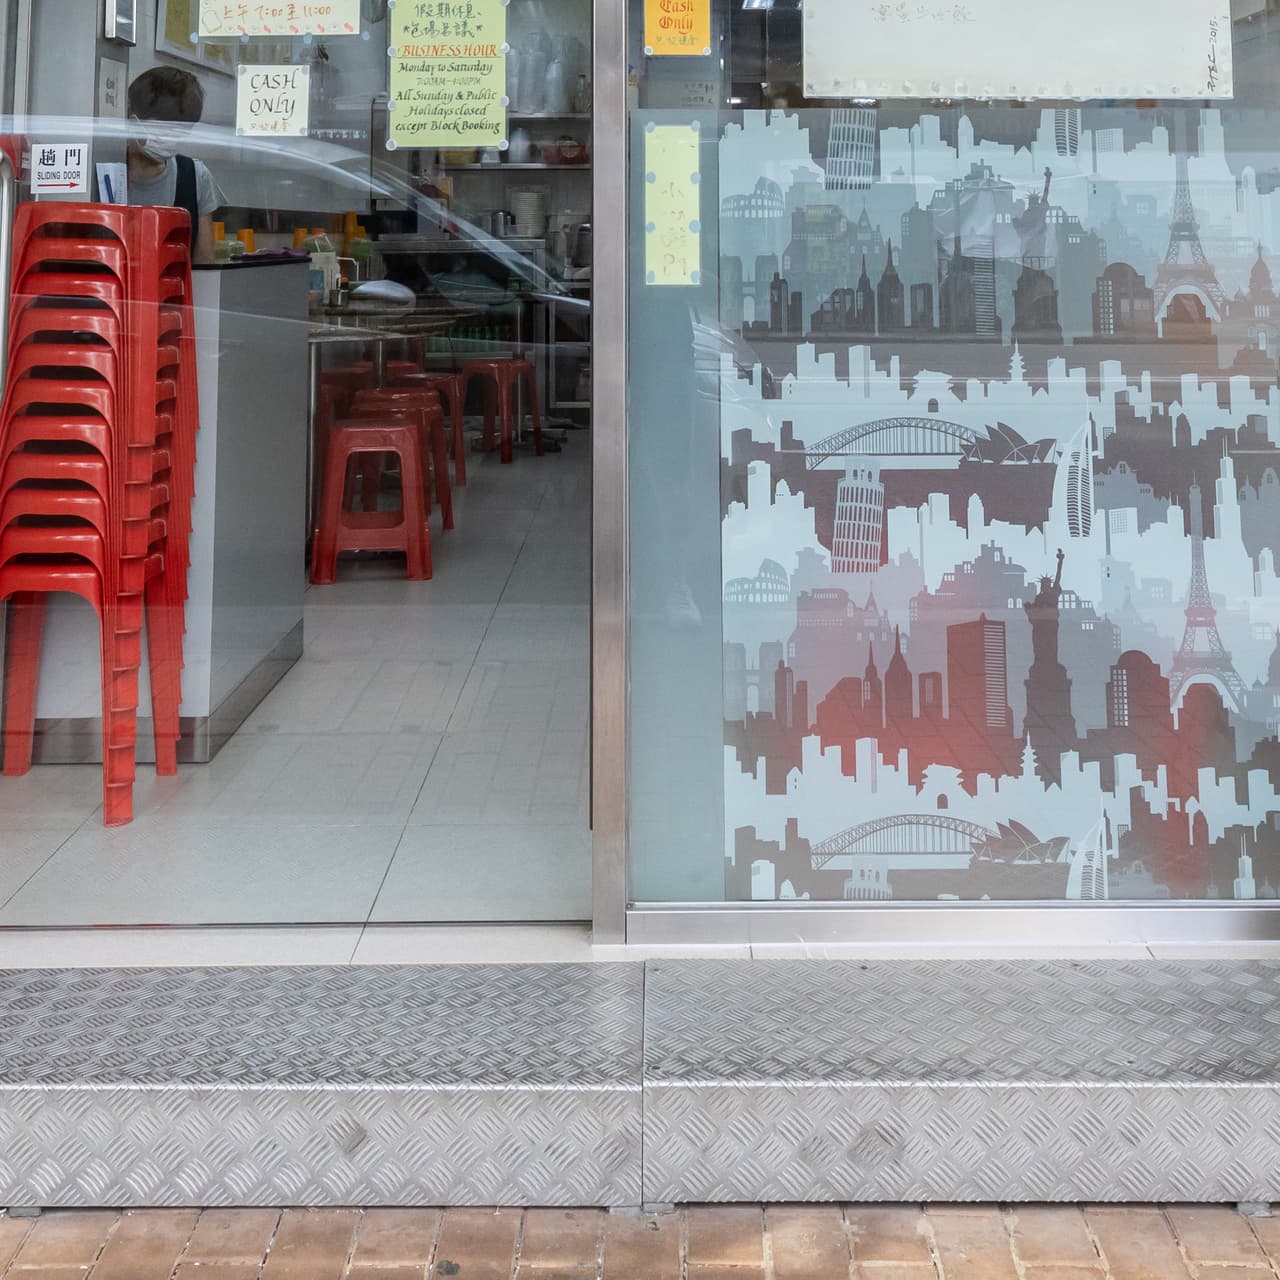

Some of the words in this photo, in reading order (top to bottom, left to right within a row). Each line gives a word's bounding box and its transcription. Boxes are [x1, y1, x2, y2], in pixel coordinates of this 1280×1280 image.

[658, 14, 694, 35] Only
[402, 45, 461, 57] BUSINESS
[463, 44, 497, 57] HOUR
[398, 60, 435, 75] Monday
[438, 64, 446, 72] to
[447, 60, 493, 76] Saturday
[250, 68, 300, 93] CASH
[395, 89, 414, 101] All
[414, 89, 453, 105] Sunday
[455, 91, 463, 100] &
[466, 88, 497, 100] Public
[249, 92, 296, 120] ONLY
[404, 105, 453, 119] Holidays
[455, 104, 491, 116] closed
[395, 122, 427, 134] except
[431, 118, 462, 134] Block
[462, 118, 502, 135] Booking
[39, 149, 81, 166] 趟門
[37, 171, 60, 180] SLIDING
[63, 171, 81, 179] DOOR
